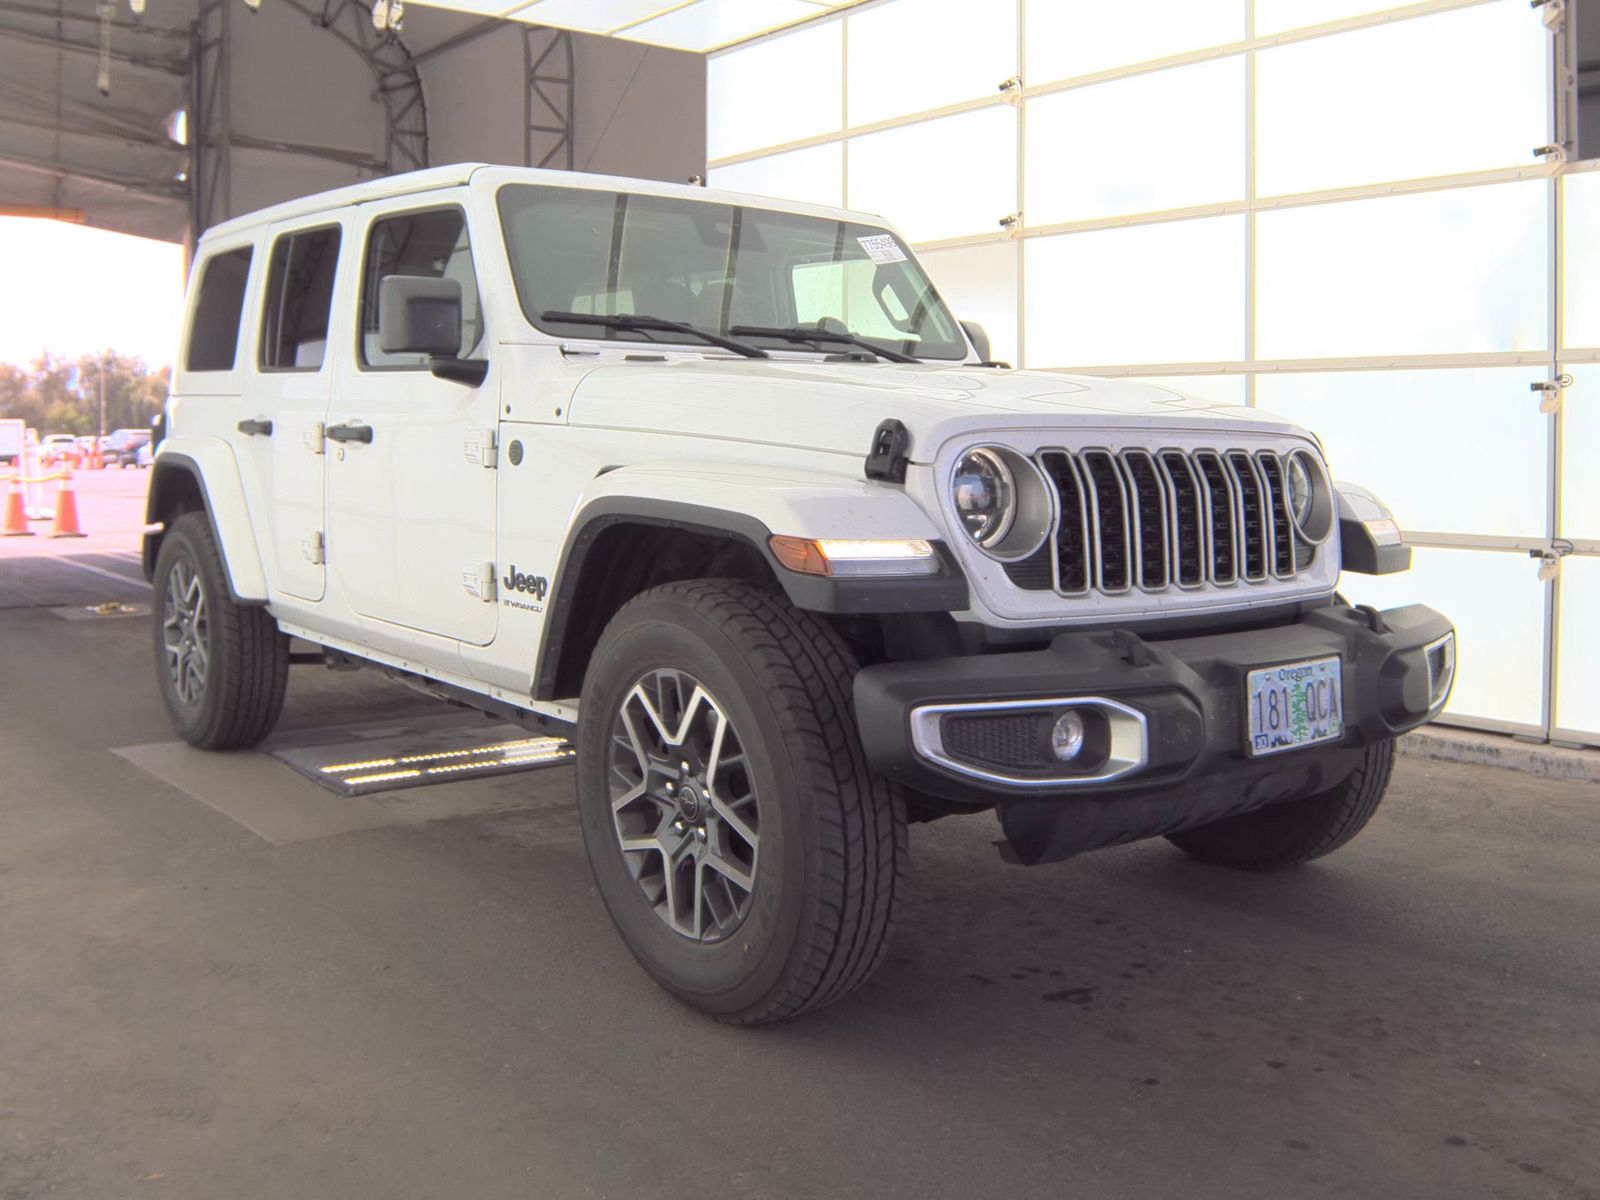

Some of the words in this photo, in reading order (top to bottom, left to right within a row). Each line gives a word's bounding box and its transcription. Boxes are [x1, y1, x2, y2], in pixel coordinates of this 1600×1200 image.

[503, 564, 548, 602] Jeep
[1278, 666, 1315, 682] Oregon
[1253, 687, 1289, 734] 181
[1304, 677, 1338, 721] QCA
